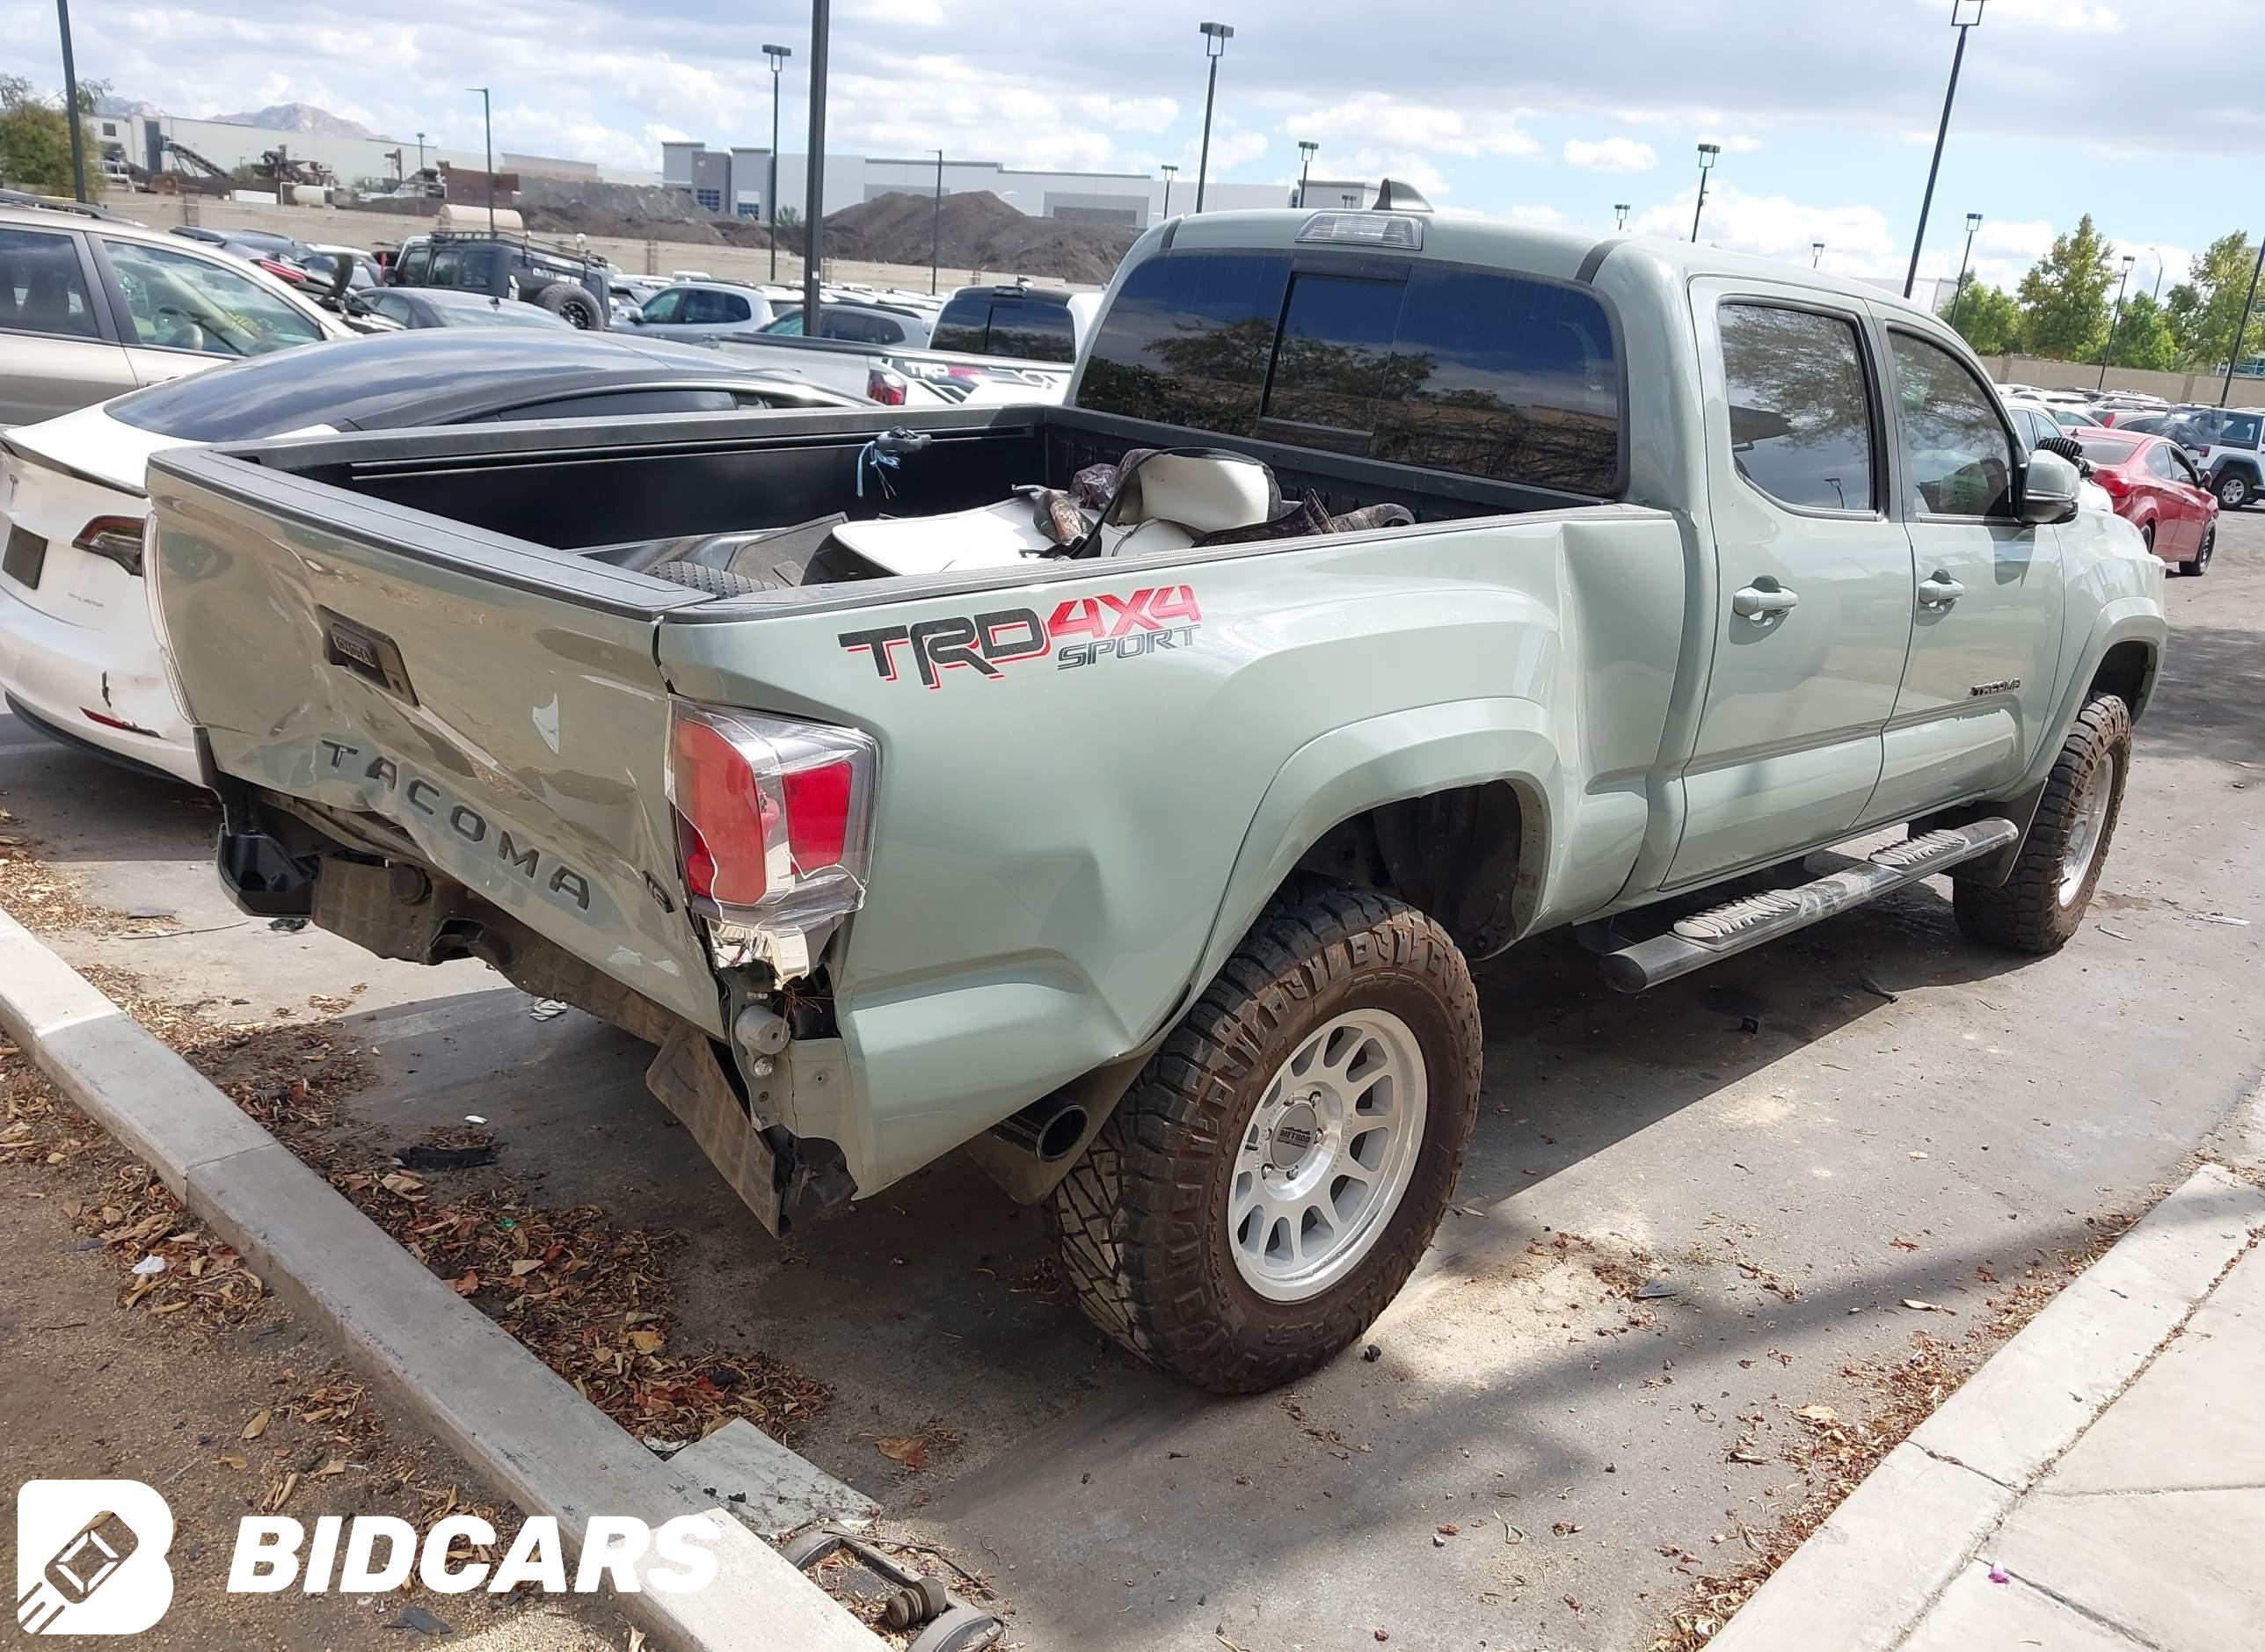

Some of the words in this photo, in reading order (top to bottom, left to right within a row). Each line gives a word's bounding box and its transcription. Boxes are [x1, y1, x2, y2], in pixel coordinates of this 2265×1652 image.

[838, 608, 1051, 689] TRD
[1050, 583, 1202, 637] 4X4
[1057, 623, 1202, 671] SPORT
[322, 739, 590, 910] TACOMA
